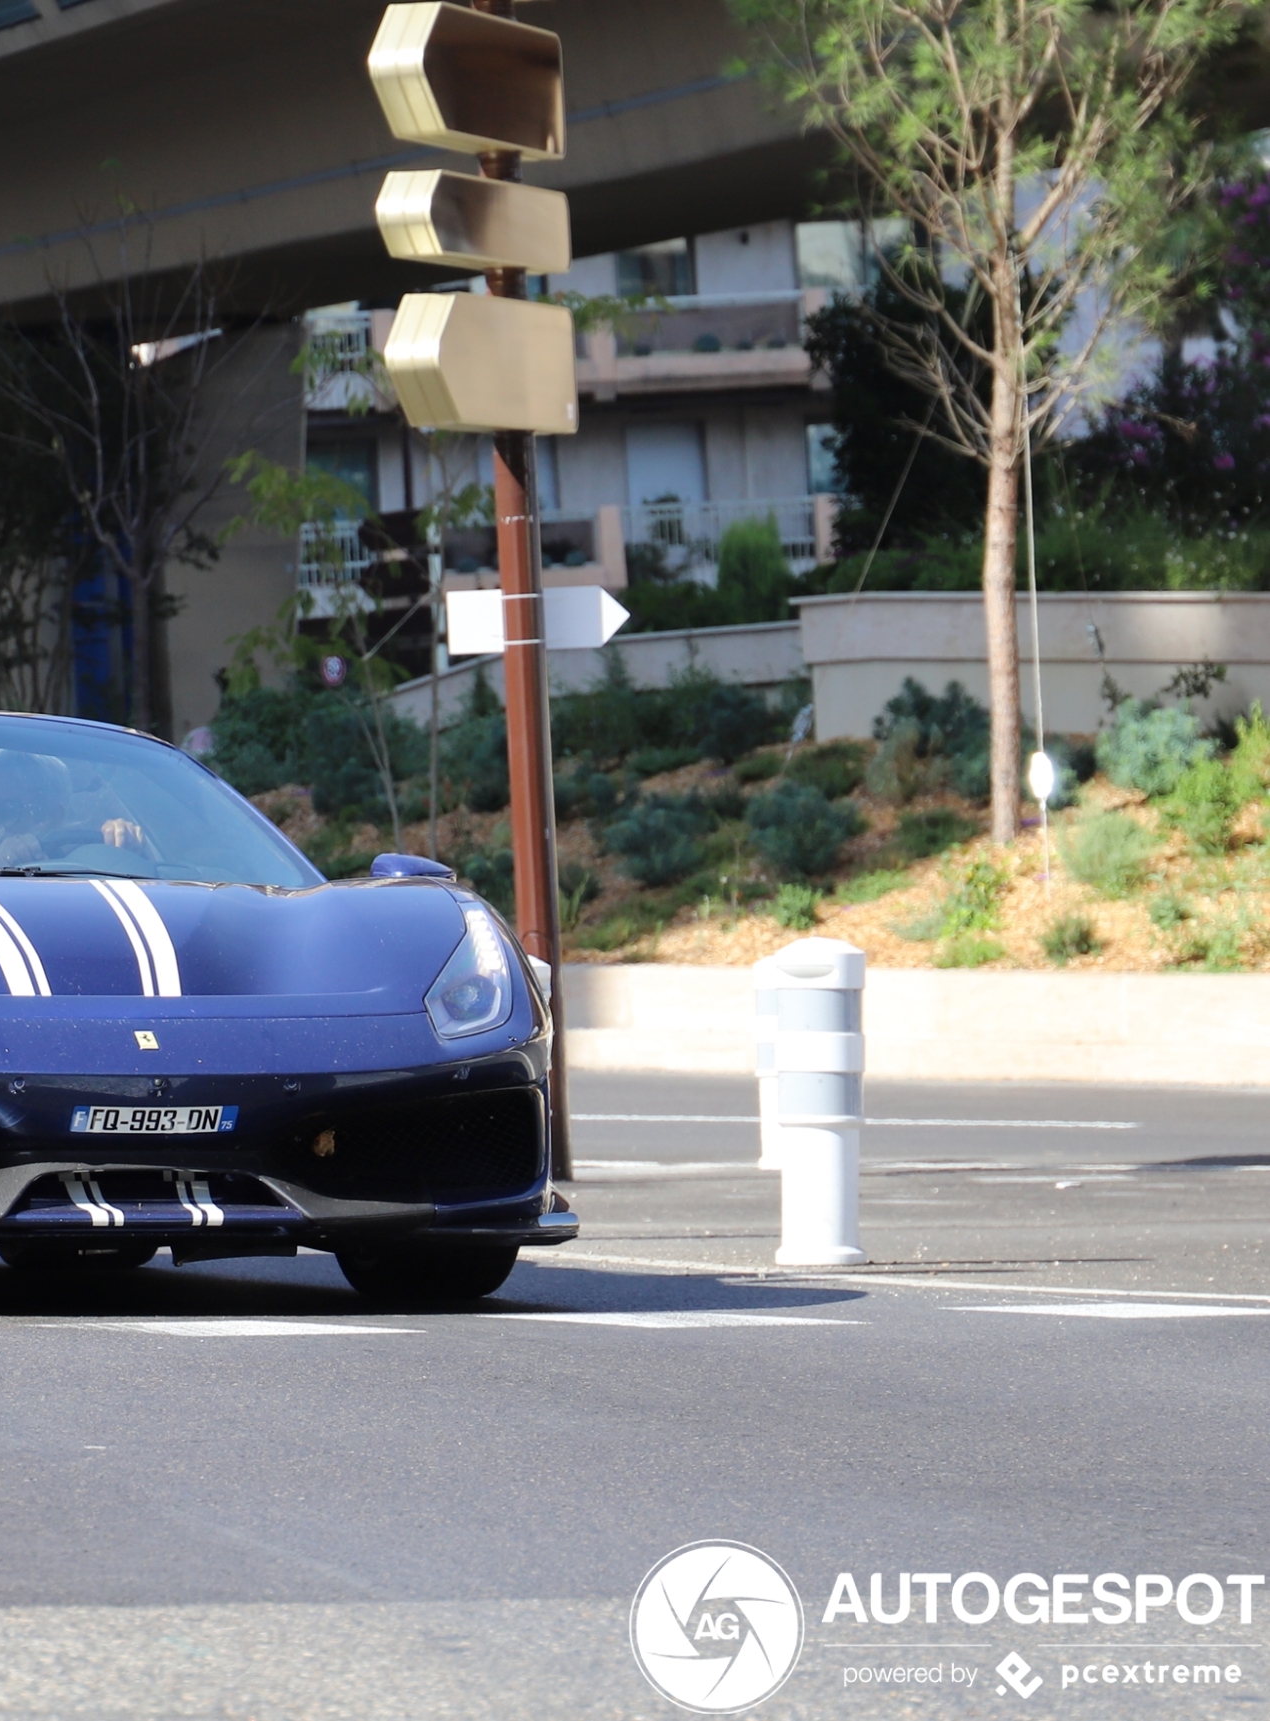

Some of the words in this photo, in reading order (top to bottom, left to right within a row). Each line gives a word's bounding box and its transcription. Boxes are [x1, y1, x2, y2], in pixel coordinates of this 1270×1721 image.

[73, 1110, 86, 1128] F
[89, 1108, 220, 1131] FQ-993-DN
[220, 1120, 233, 1130] 75
